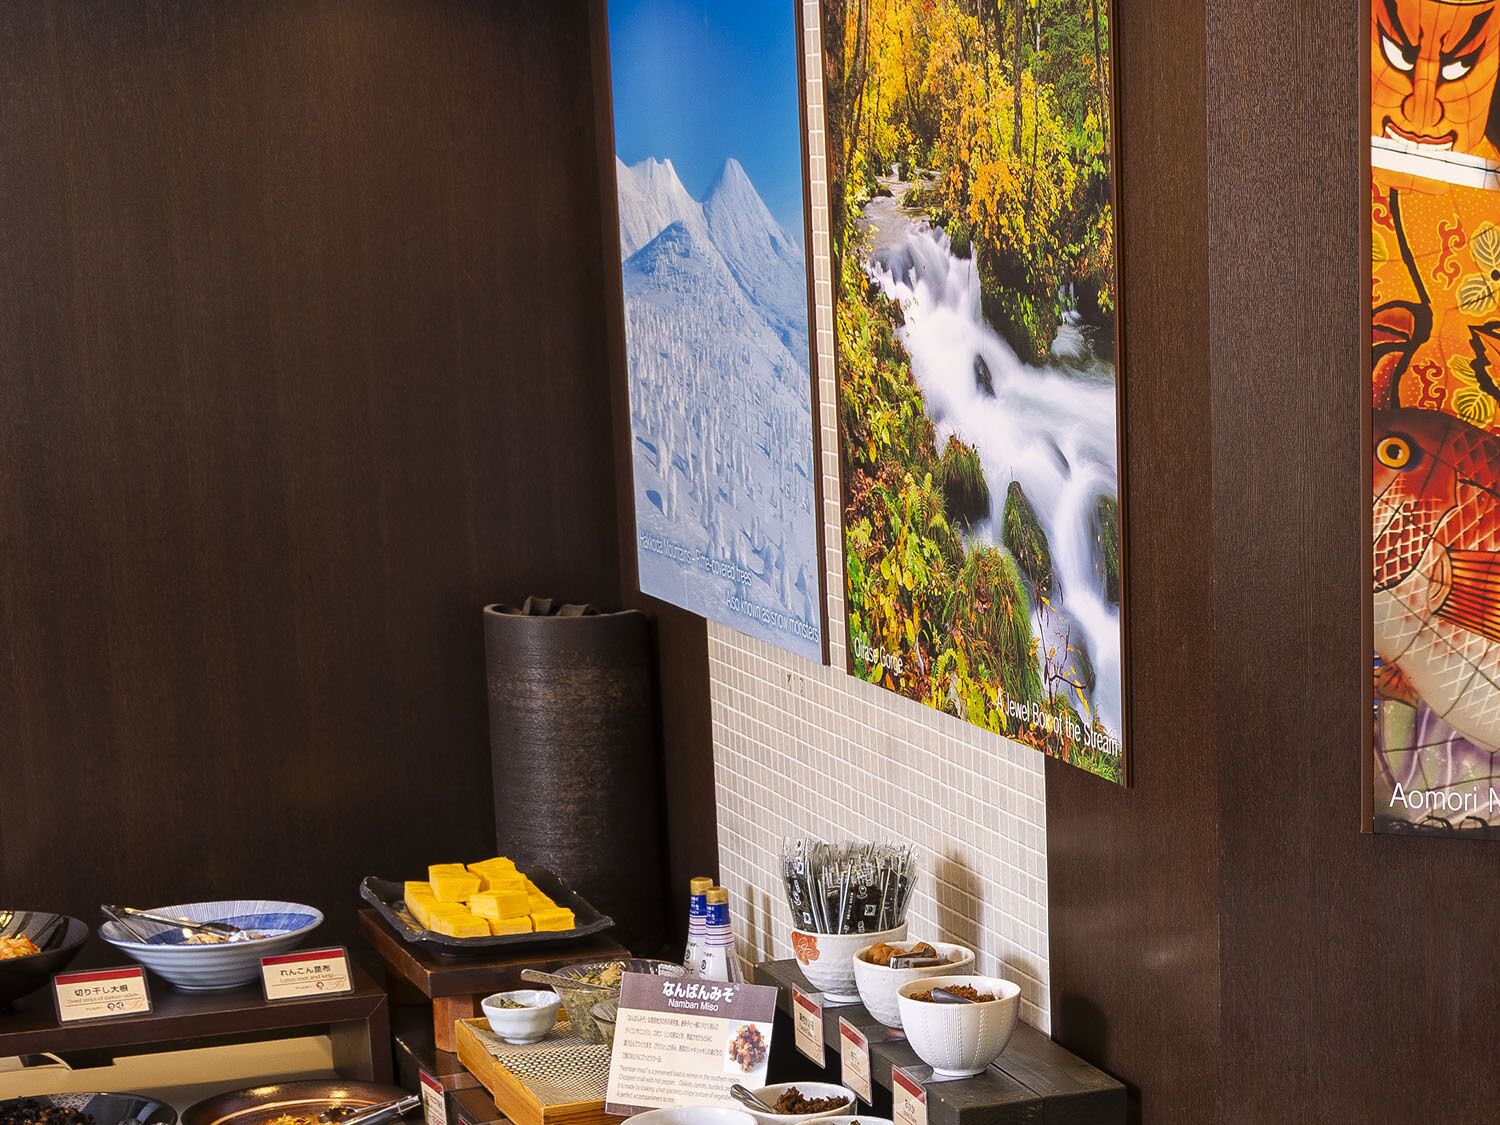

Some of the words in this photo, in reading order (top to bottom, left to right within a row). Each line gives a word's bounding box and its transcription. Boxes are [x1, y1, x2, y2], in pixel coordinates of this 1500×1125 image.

[880, 646, 903, 676] Gorge
[996, 688, 1004, 714] A
[1006, 693, 1030, 722] Jewel
[1032, 703, 1050, 730] Box
[1054, 713, 1063, 734] of
[1066, 716, 1080, 742] the
[1084, 722, 1119, 756] Stream
[1389, 782, 1477, 812] Aomori
[280, 965, 331, 976] れんこん昆布
[74, 984, 128, 997] 切り干し大根
[662, 981, 735, 1003] なんばんみそ
[668, 999, 699, 1010] Namban
[700, 1001, 719, 1012] Miso
